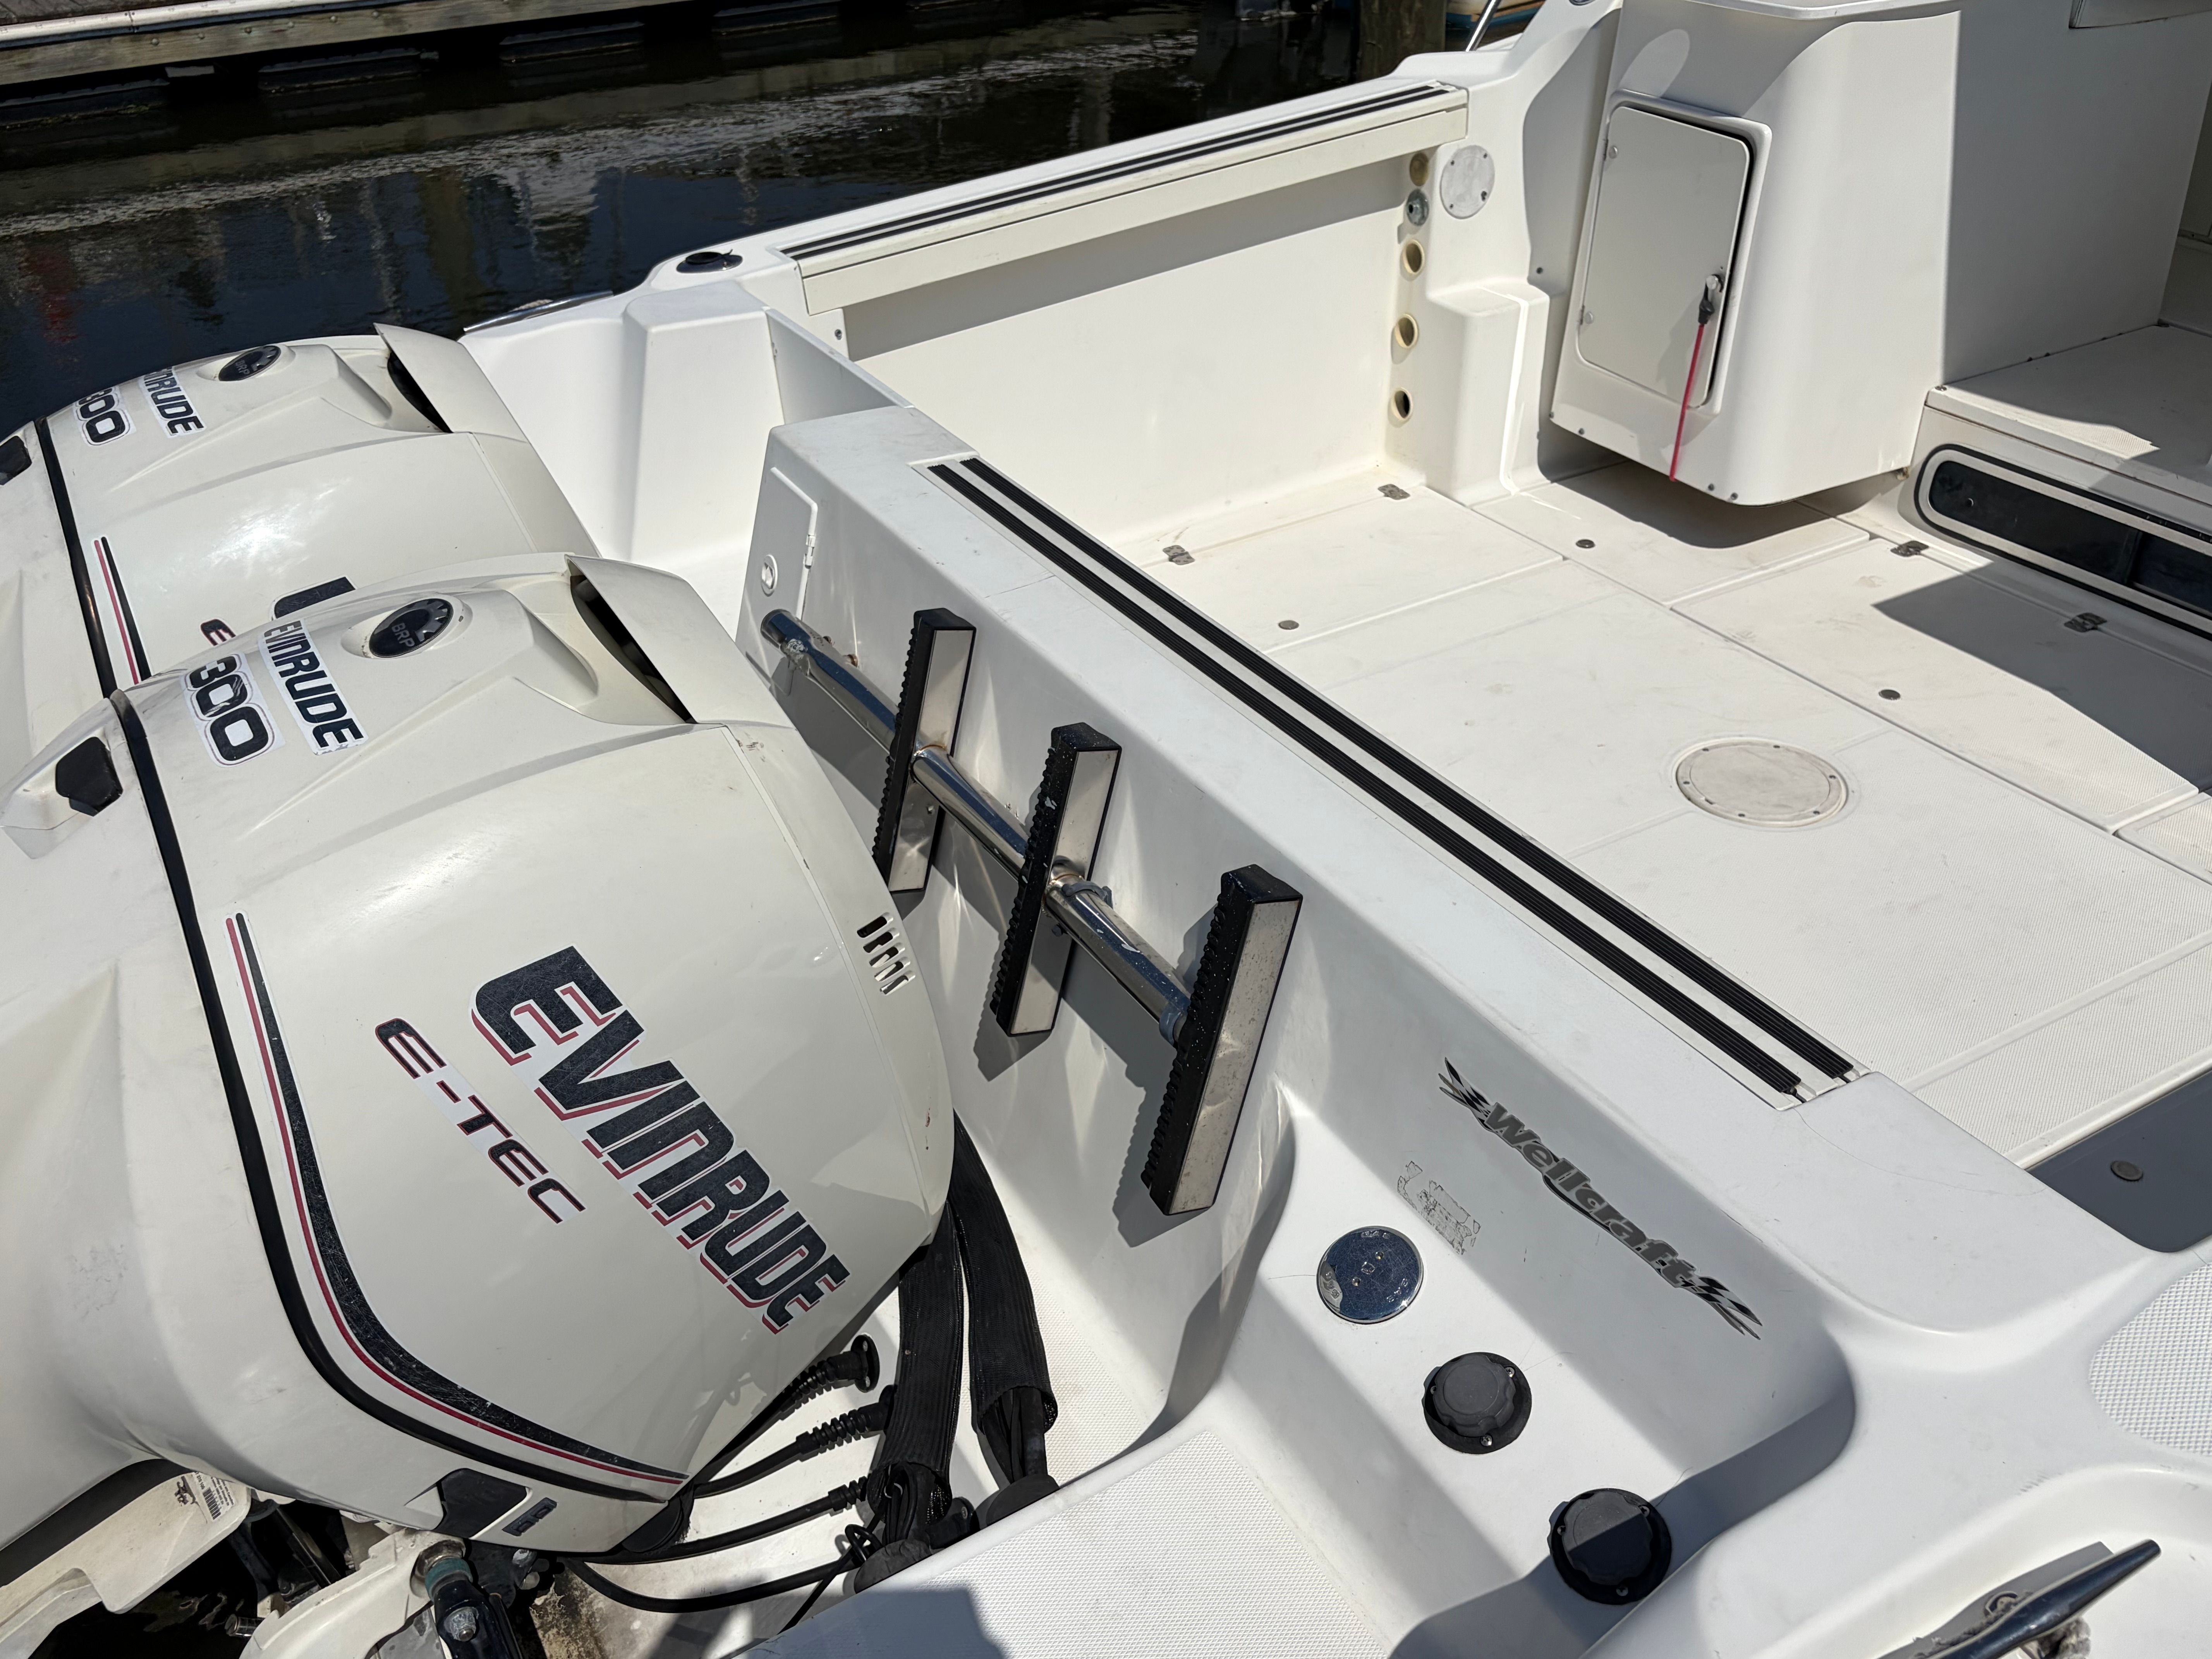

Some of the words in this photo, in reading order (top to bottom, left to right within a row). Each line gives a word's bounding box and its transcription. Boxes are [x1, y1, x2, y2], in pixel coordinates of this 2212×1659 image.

[235, 359, 251, 375] BRP
[264, 620, 364, 748] EVINRUDE
[391, 622, 416, 647] BRP
[189, 654, 269, 762] 300
[374, 1018, 586, 1224] E-TEC
[471, 945, 851, 1335] EVINRUDE
[1485, 1102, 1695, 1287] Wellcraft
